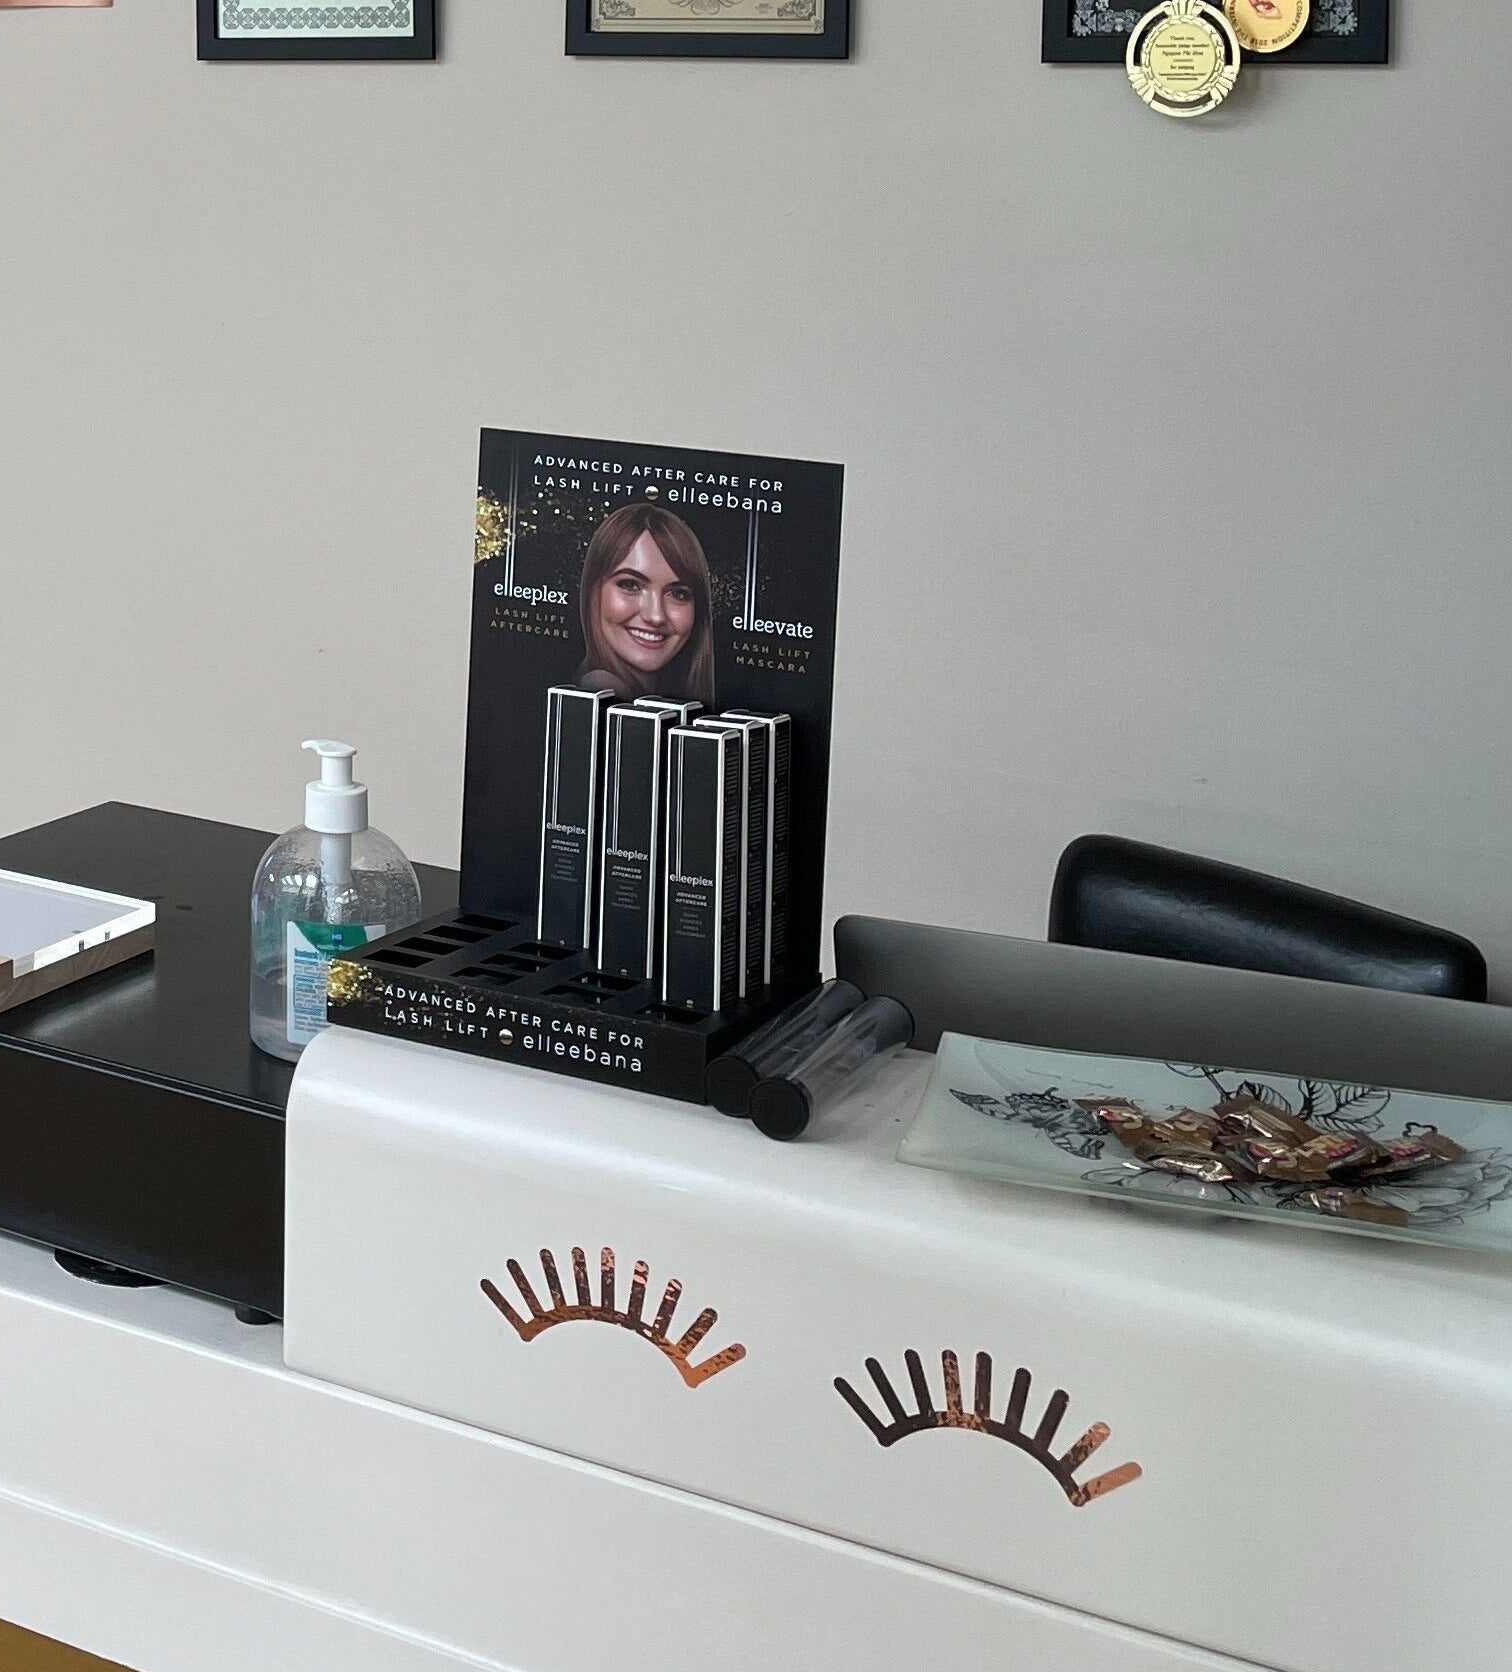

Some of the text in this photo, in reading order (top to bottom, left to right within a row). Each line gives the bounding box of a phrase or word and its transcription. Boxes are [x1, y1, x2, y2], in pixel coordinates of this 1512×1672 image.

[534, 455, 784, 493] ADVANCED AFTER CARE FOR
[534, 475, 783, 514] LASH LIFT elleebana
[494, 580, 568, 607] elleeplex
[490, 619, 570, 640] AFTERCARE
[495, 607, 566, 625] LASH LIFT
[732, 612, 814, 640] elleevate
[732, 640, 812, 661] LASH LIFT
[736, 655, 807, 674] MASCARA
[670, 873, 714, 888] elleeplex
[384, 986, 645, 1049] ADVANCED AFTER CARE FOR
[385, 1006, 642, 1073] LASH LIFT elleebana
